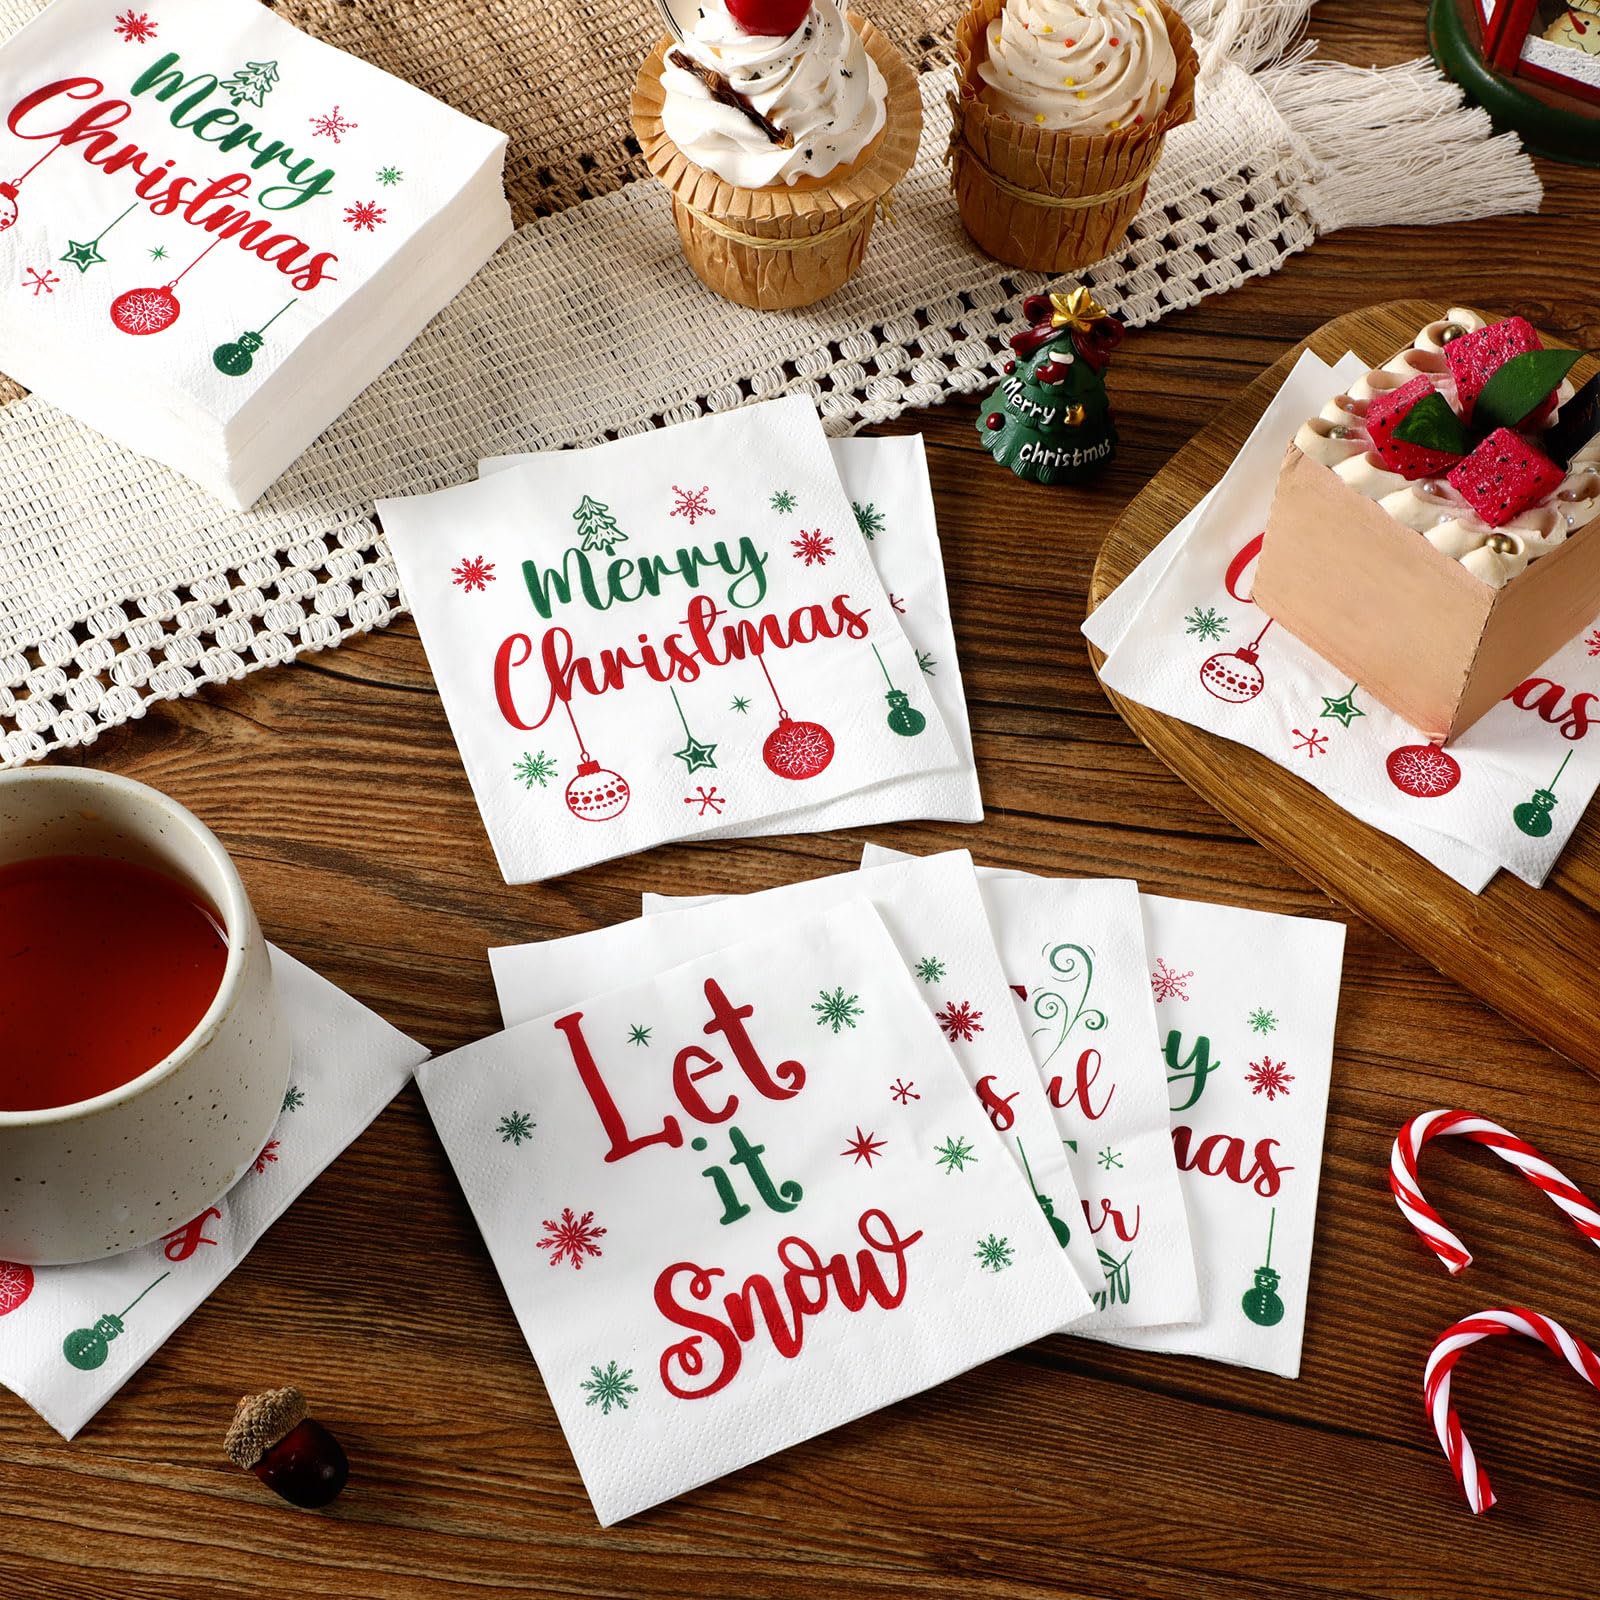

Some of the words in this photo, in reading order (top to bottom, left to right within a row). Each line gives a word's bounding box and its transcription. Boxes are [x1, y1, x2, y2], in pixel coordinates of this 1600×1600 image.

[7, 77, 338, 291] Christmas
[130, 52, 335, 210] Merry
[1002, 376, 1056, 425] Merry
[522, 536, 769, 618] Merry
[494, 594, 871, 731] Christmas
[555, 978, 807, 1163] Let
[691, 1125, 804, 1226] it
[653, 1208, 924, 1400] Snow
